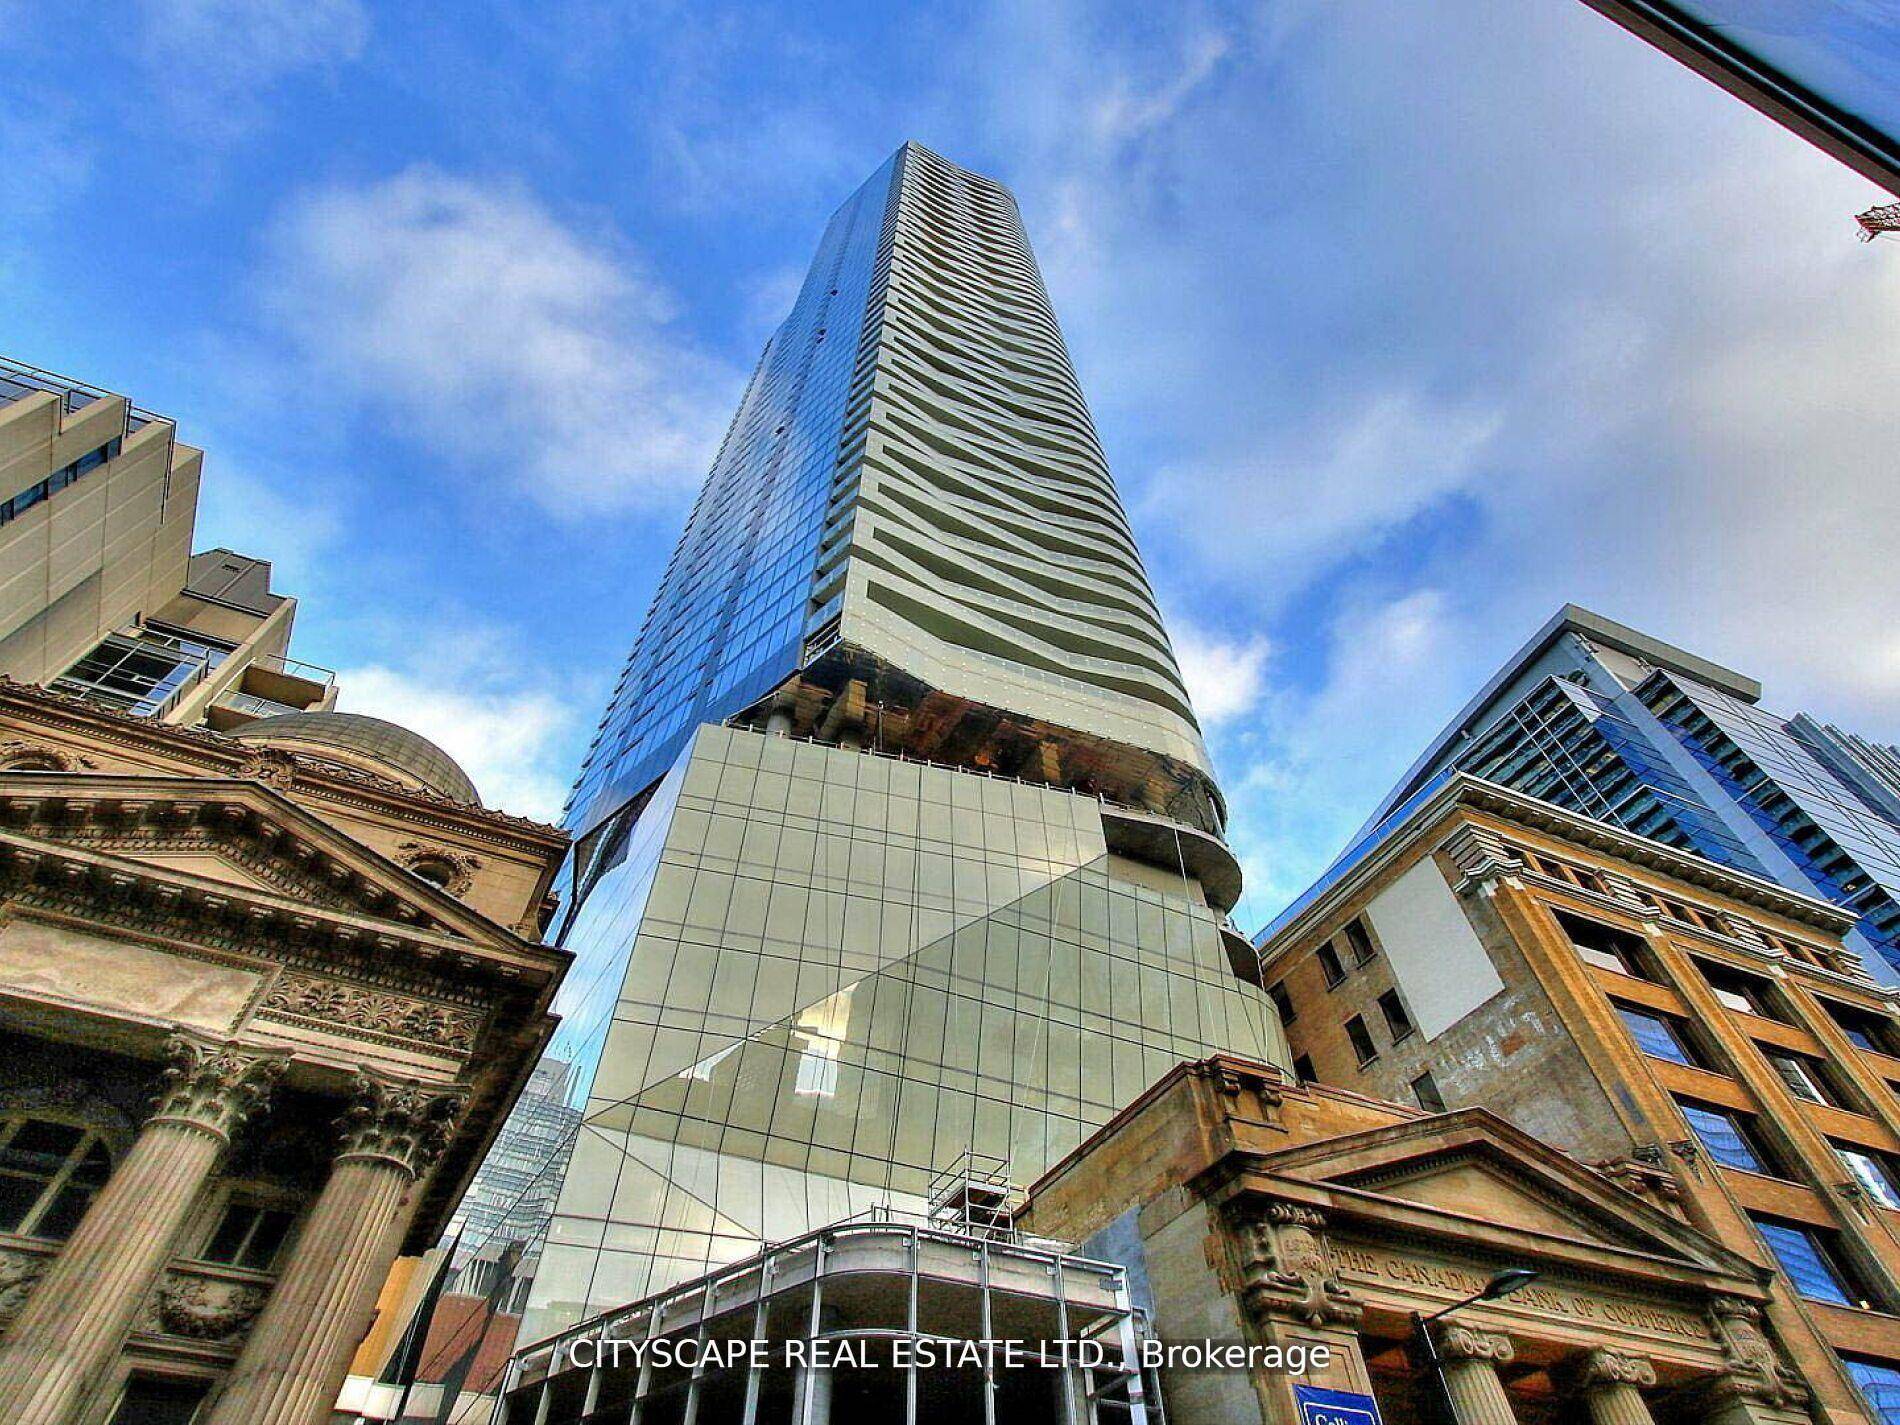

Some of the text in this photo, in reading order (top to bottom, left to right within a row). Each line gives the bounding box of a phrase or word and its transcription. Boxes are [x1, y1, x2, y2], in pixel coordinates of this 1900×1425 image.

[1331, 1248, 1379, 1276] THE
[1386, 1257, 1488, 1296] CANADIA
[1571, 1297, 1595, 1318] OF
